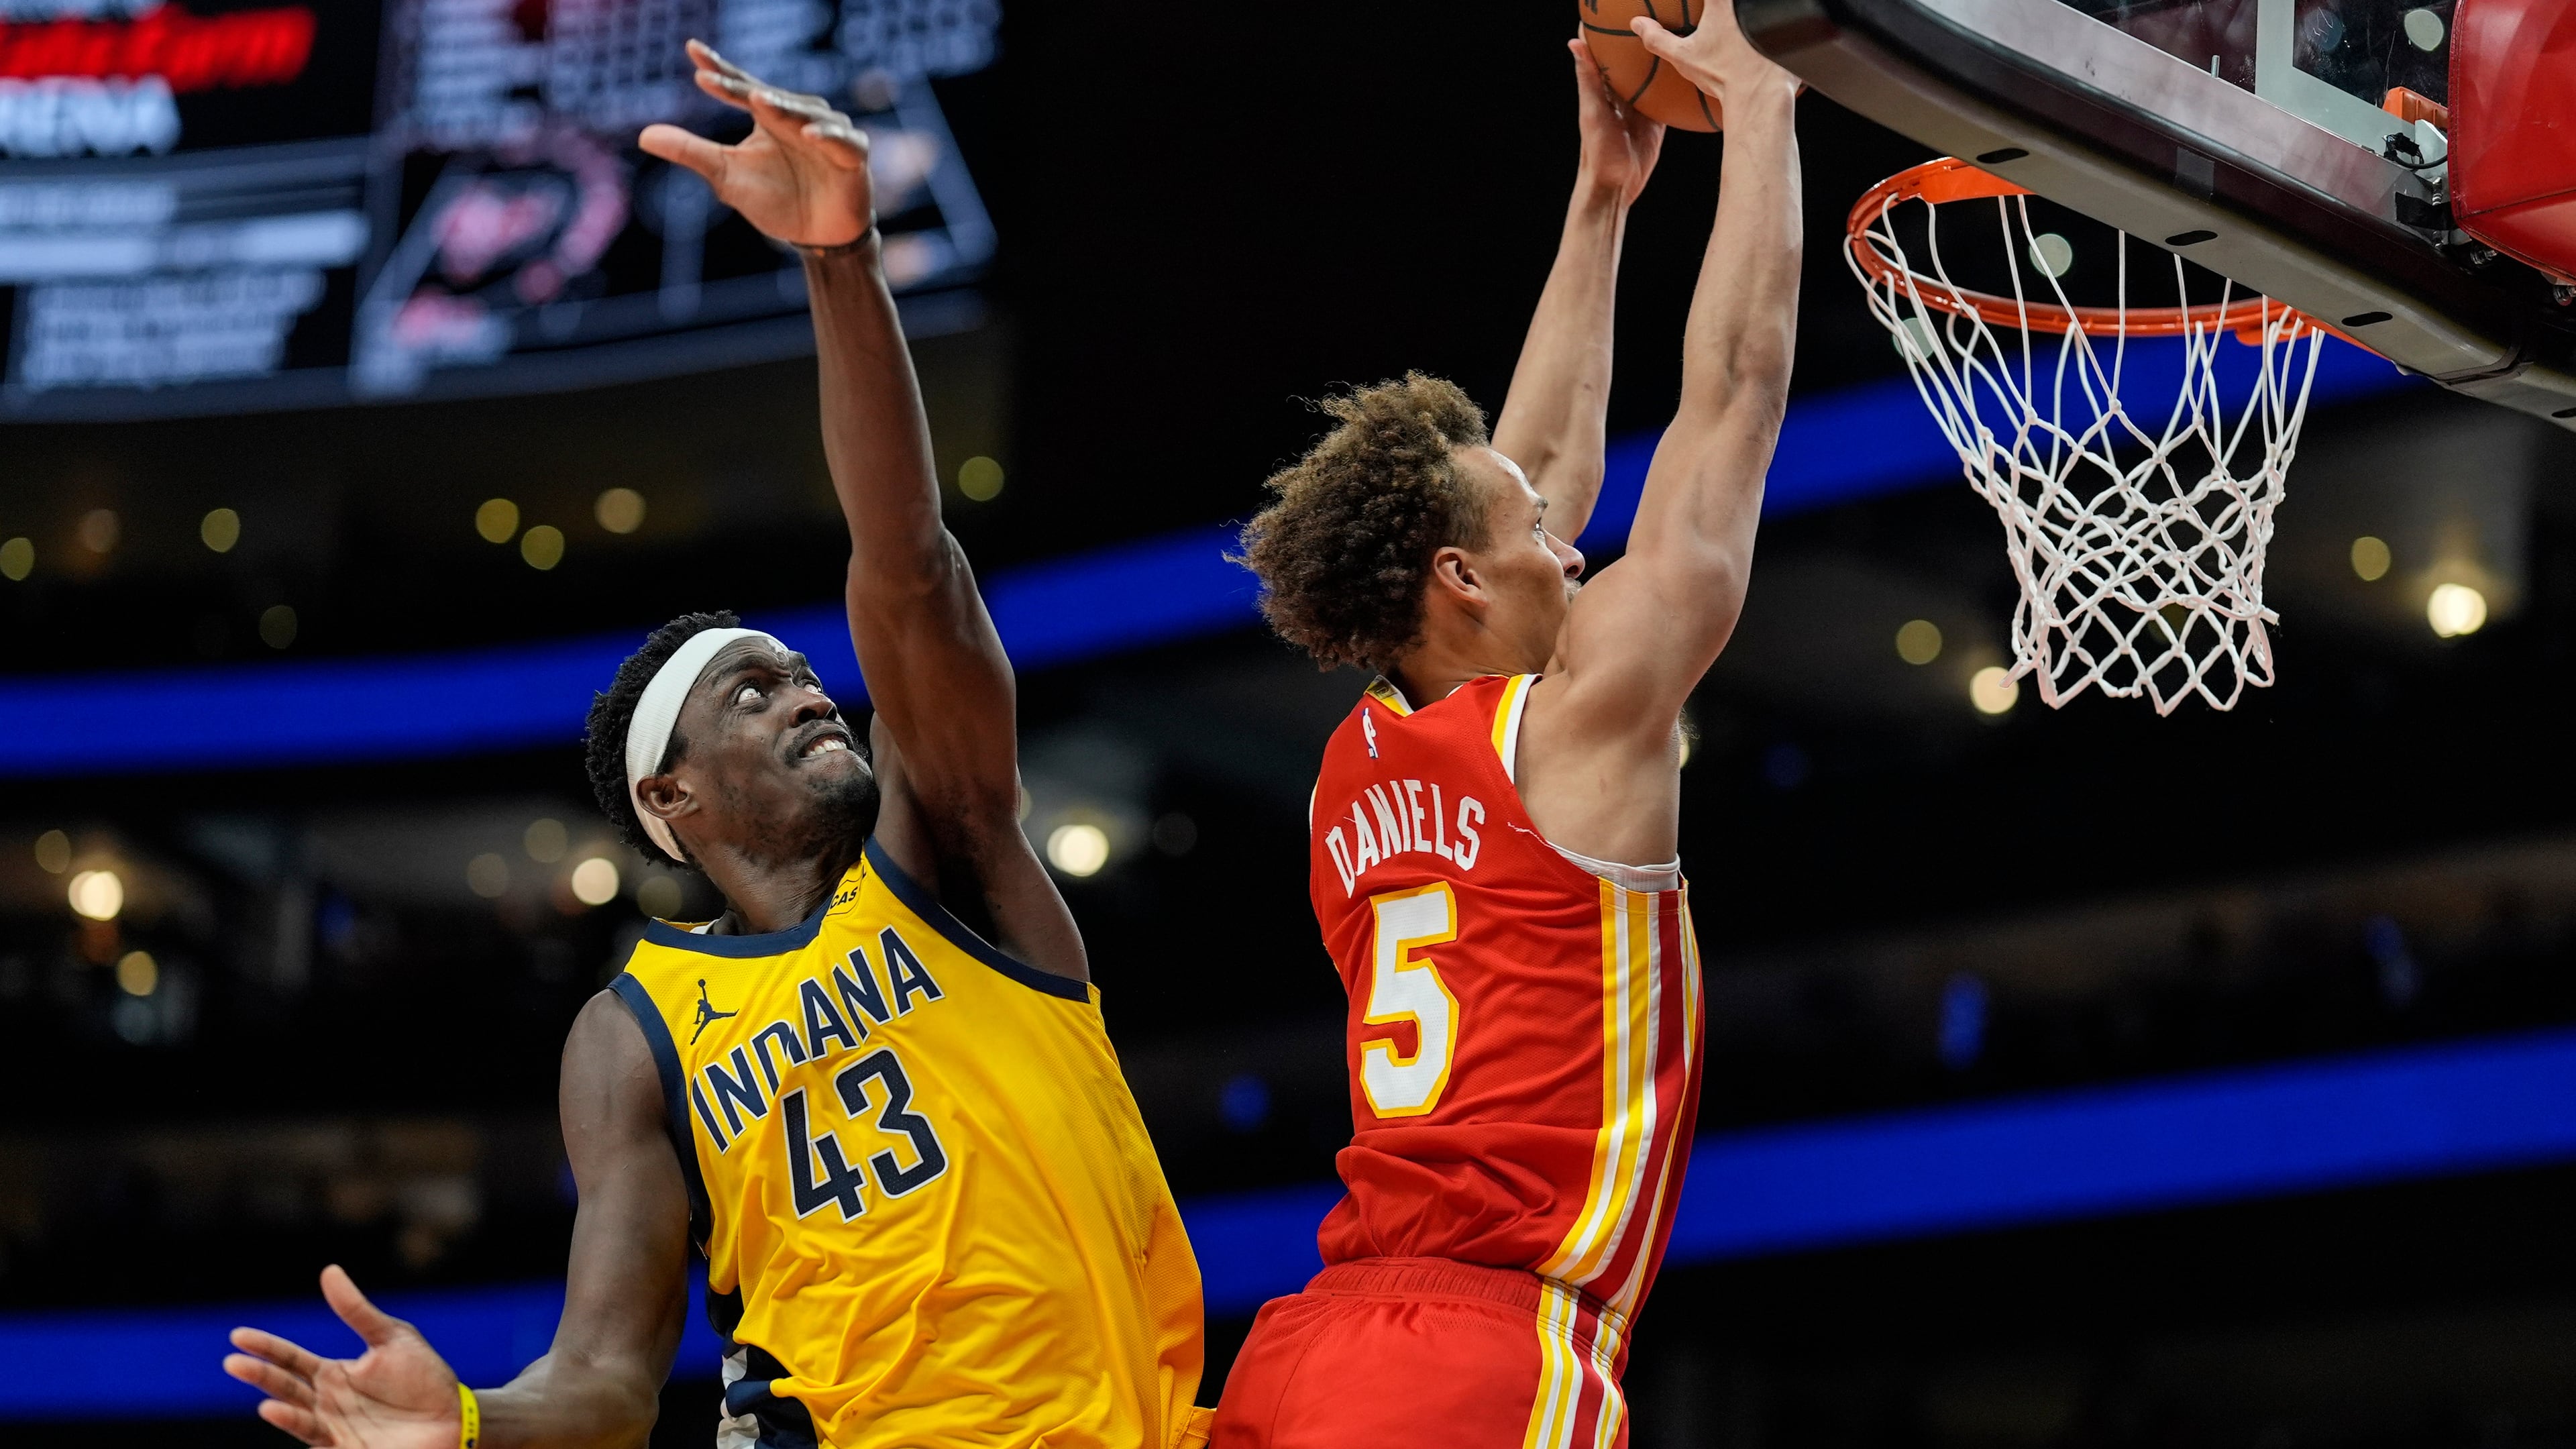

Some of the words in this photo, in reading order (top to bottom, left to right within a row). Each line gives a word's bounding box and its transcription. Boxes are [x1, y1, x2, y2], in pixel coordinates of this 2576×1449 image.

[1324, 780, 1485, 899] DANIELS
[1360, 880, 1460, 1119] 5
[780, 1047, 949, 1224] 43
